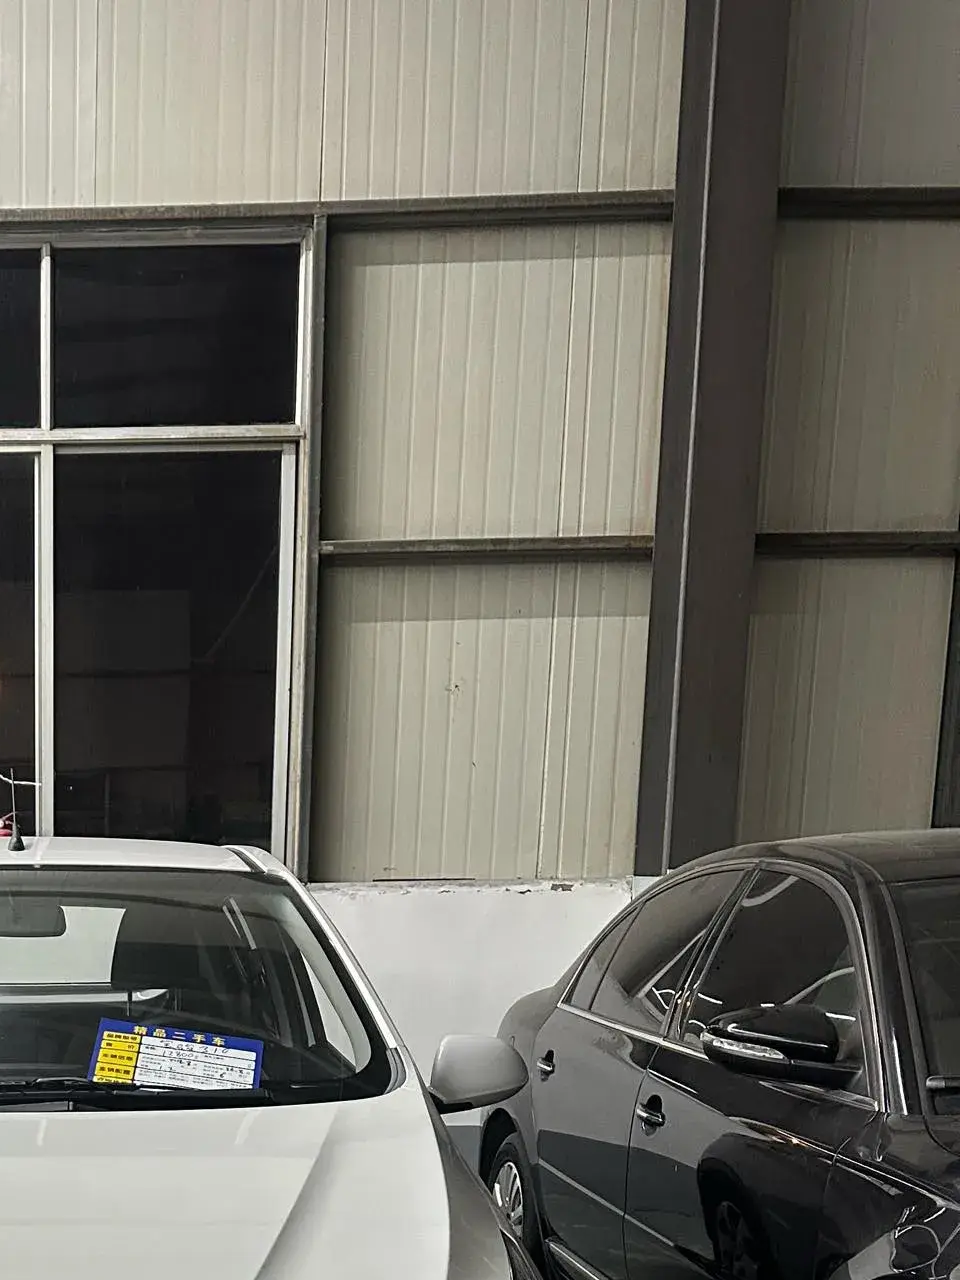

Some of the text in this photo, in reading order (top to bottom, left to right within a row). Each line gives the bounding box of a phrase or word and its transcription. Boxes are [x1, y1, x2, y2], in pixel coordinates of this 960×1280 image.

[133, 1025, 226, 1047] 精品二手车
